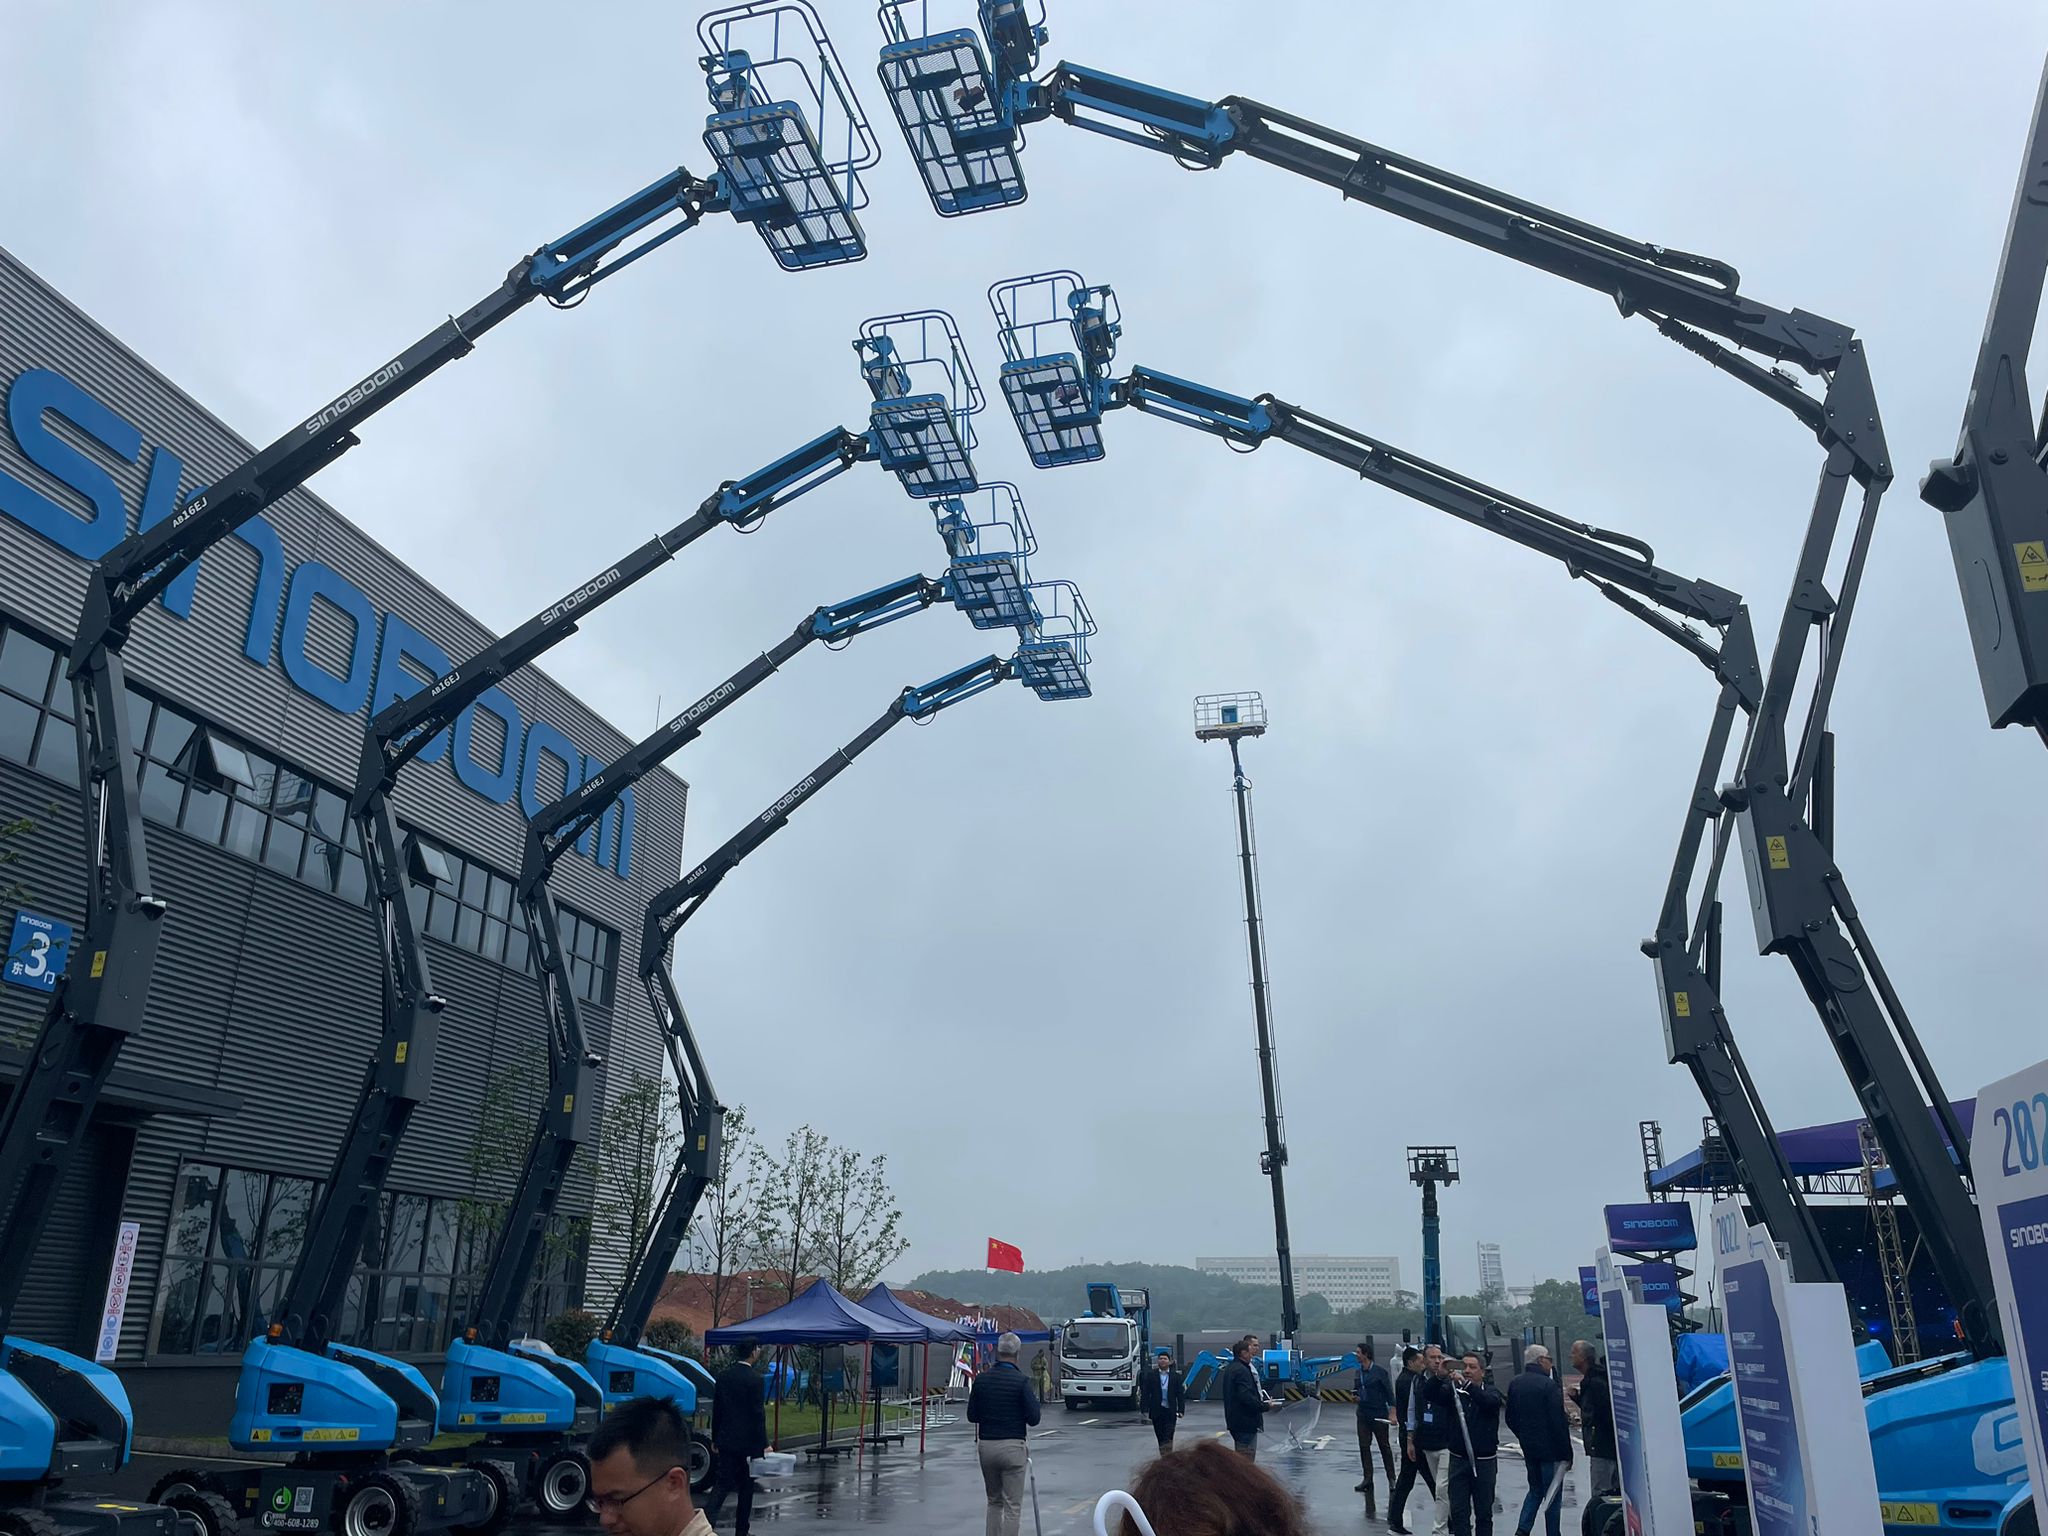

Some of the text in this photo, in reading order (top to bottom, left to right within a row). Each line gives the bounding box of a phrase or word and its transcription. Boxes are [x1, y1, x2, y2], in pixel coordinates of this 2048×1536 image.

[305, 360, 404, 435] SINOBOOM
[172, 496, 208, 528] AB16EJ
[540, 568, 621, 626] SINOBOOM
[431, 671, 461, 697] AB16EJ
[669, 681, 736, 733] SINOBOOM
[761, 775, 817, 823] SINOBOOM
[24, 931, 51, 977] 3
[1623, 1218, 1679, 1229] SINOBOOM
